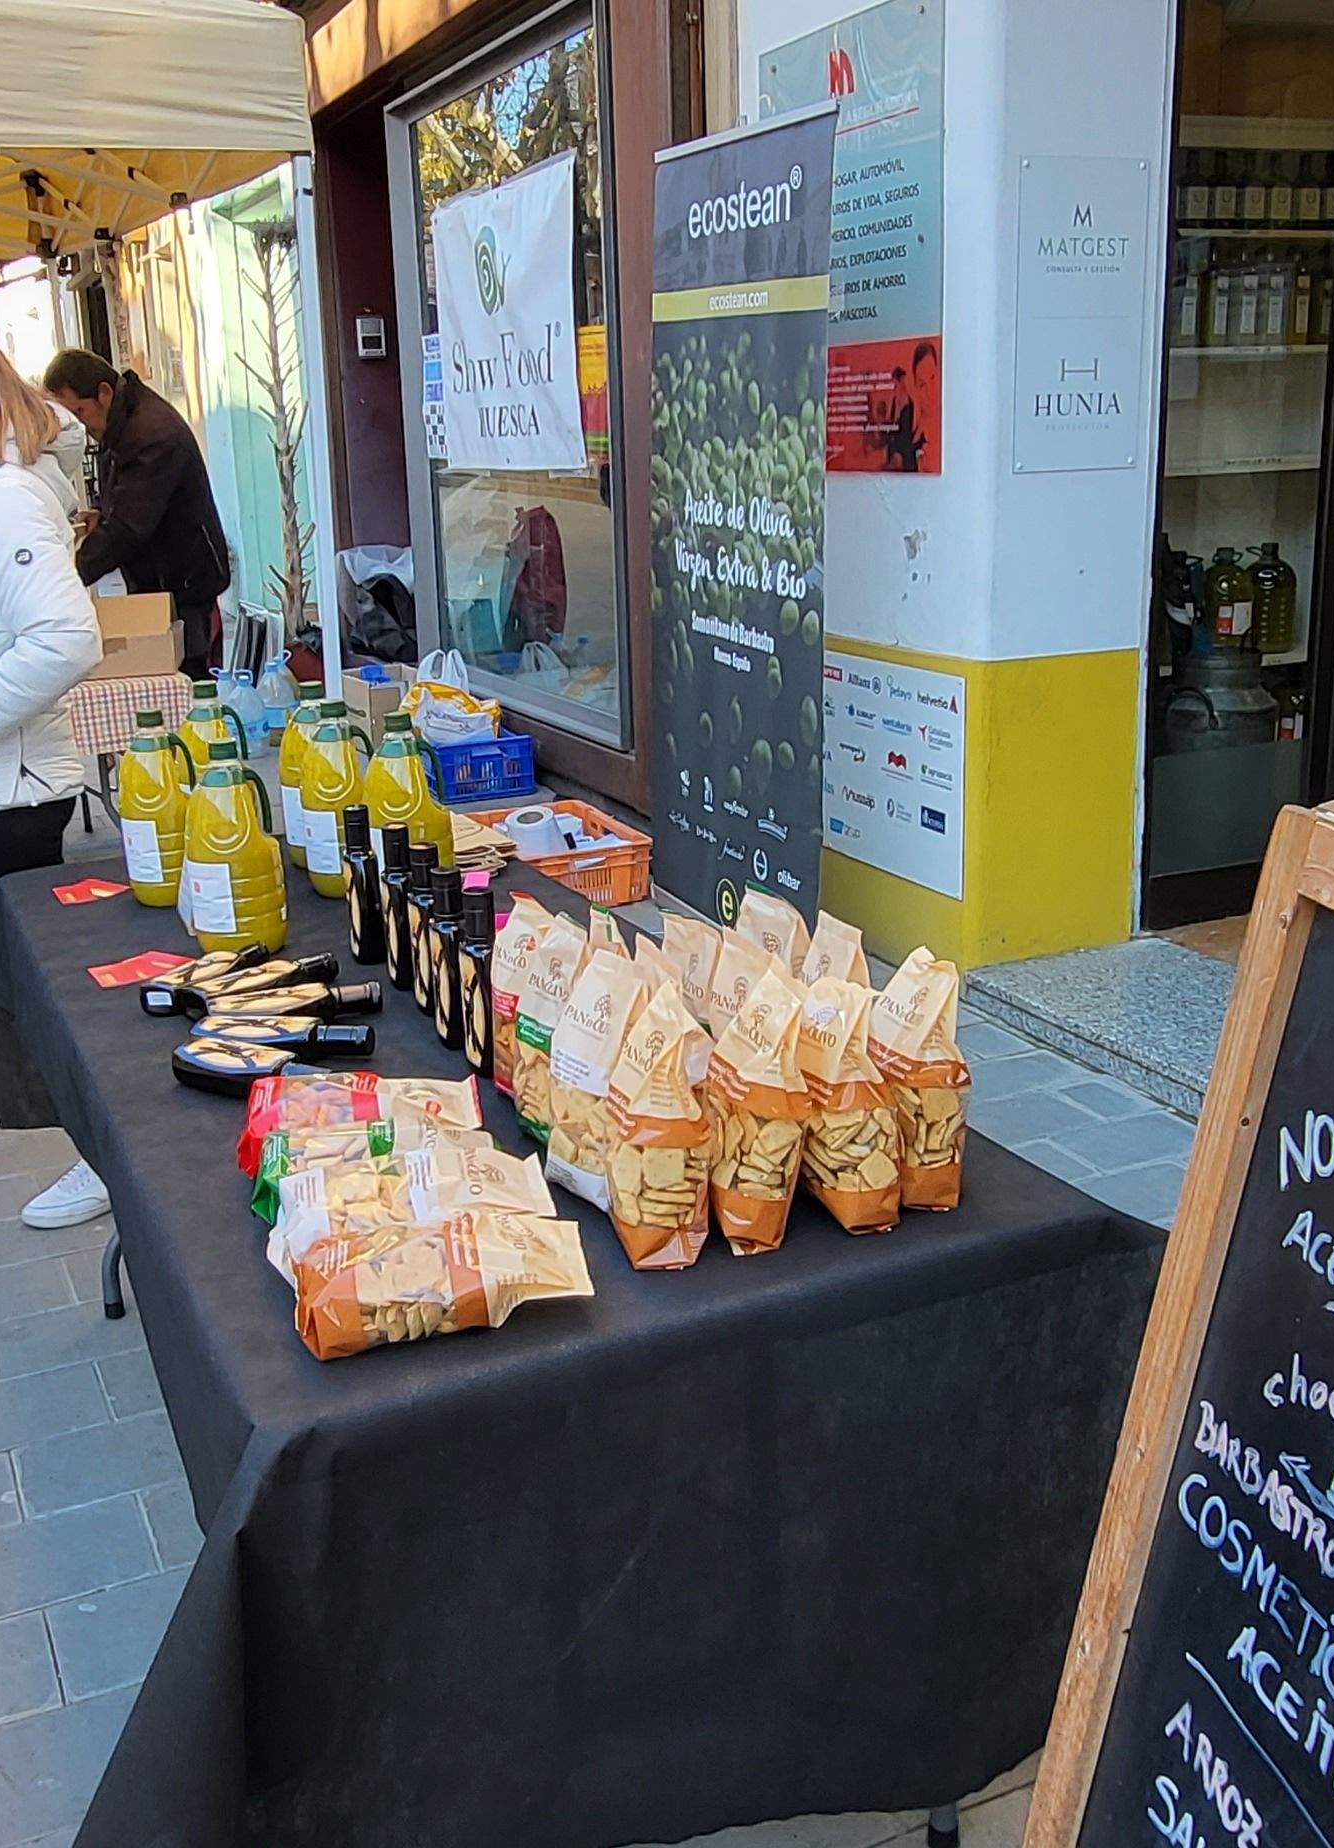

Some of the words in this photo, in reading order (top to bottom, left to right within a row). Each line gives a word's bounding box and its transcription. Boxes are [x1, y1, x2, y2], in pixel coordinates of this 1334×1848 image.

[884, 183, 920, 203] SEGUROS
[858, 214, 914, 238] COMUNIDADES
[849, 244, 907, 266] EXPLOTACIONES
[1037, 237, 1130, 257] MATGEST
[709, 291, 769, 311] ecostean.com
[1034, 392, 1122, 417] HUNIA
[478, 404, 541, 438] HUESCA
[684, 489, 723, 528] Aceite
[727, 492, 745, 531] de
[749, 497, 796, 538] Oliva
[675, 539, 713, 591] Virgen
[717, 546, 758, 590] Extra
[776, 559, 807, 599] Bio
[692, 610, 730, 641] Somontano
[739, 623, 775, 654] Barbastro
